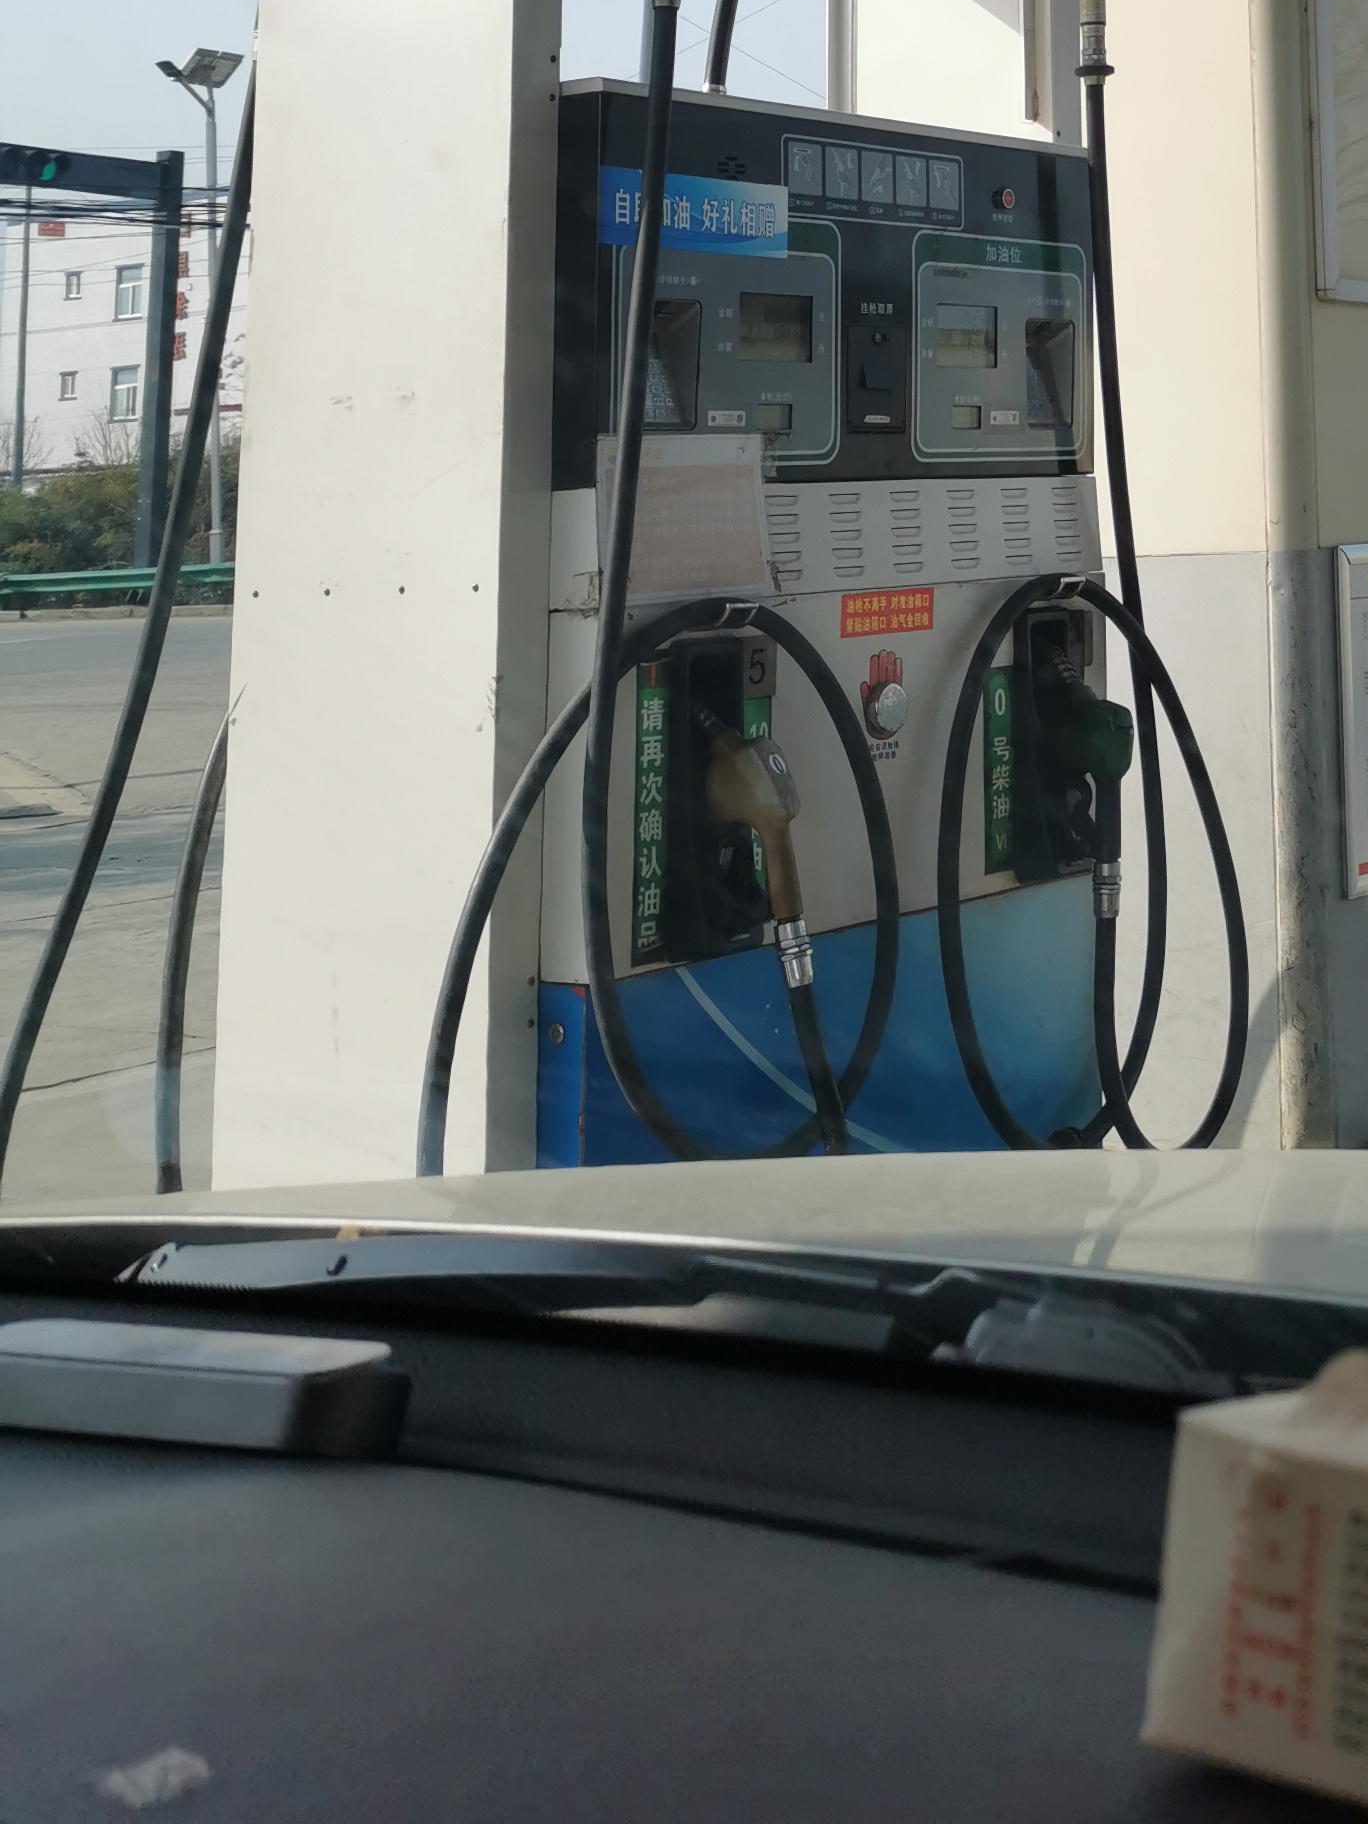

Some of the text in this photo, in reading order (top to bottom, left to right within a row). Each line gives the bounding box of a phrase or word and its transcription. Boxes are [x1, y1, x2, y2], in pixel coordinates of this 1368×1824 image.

[701, 198, 776, 238] 好礼相赠
[985, 244, 1022, 264] 加油位
[846, 596, 887, 614] 油枪不离手
[747, 648, 766, 686] 5
[637, 697, 665, 948] 请再次确认油品
